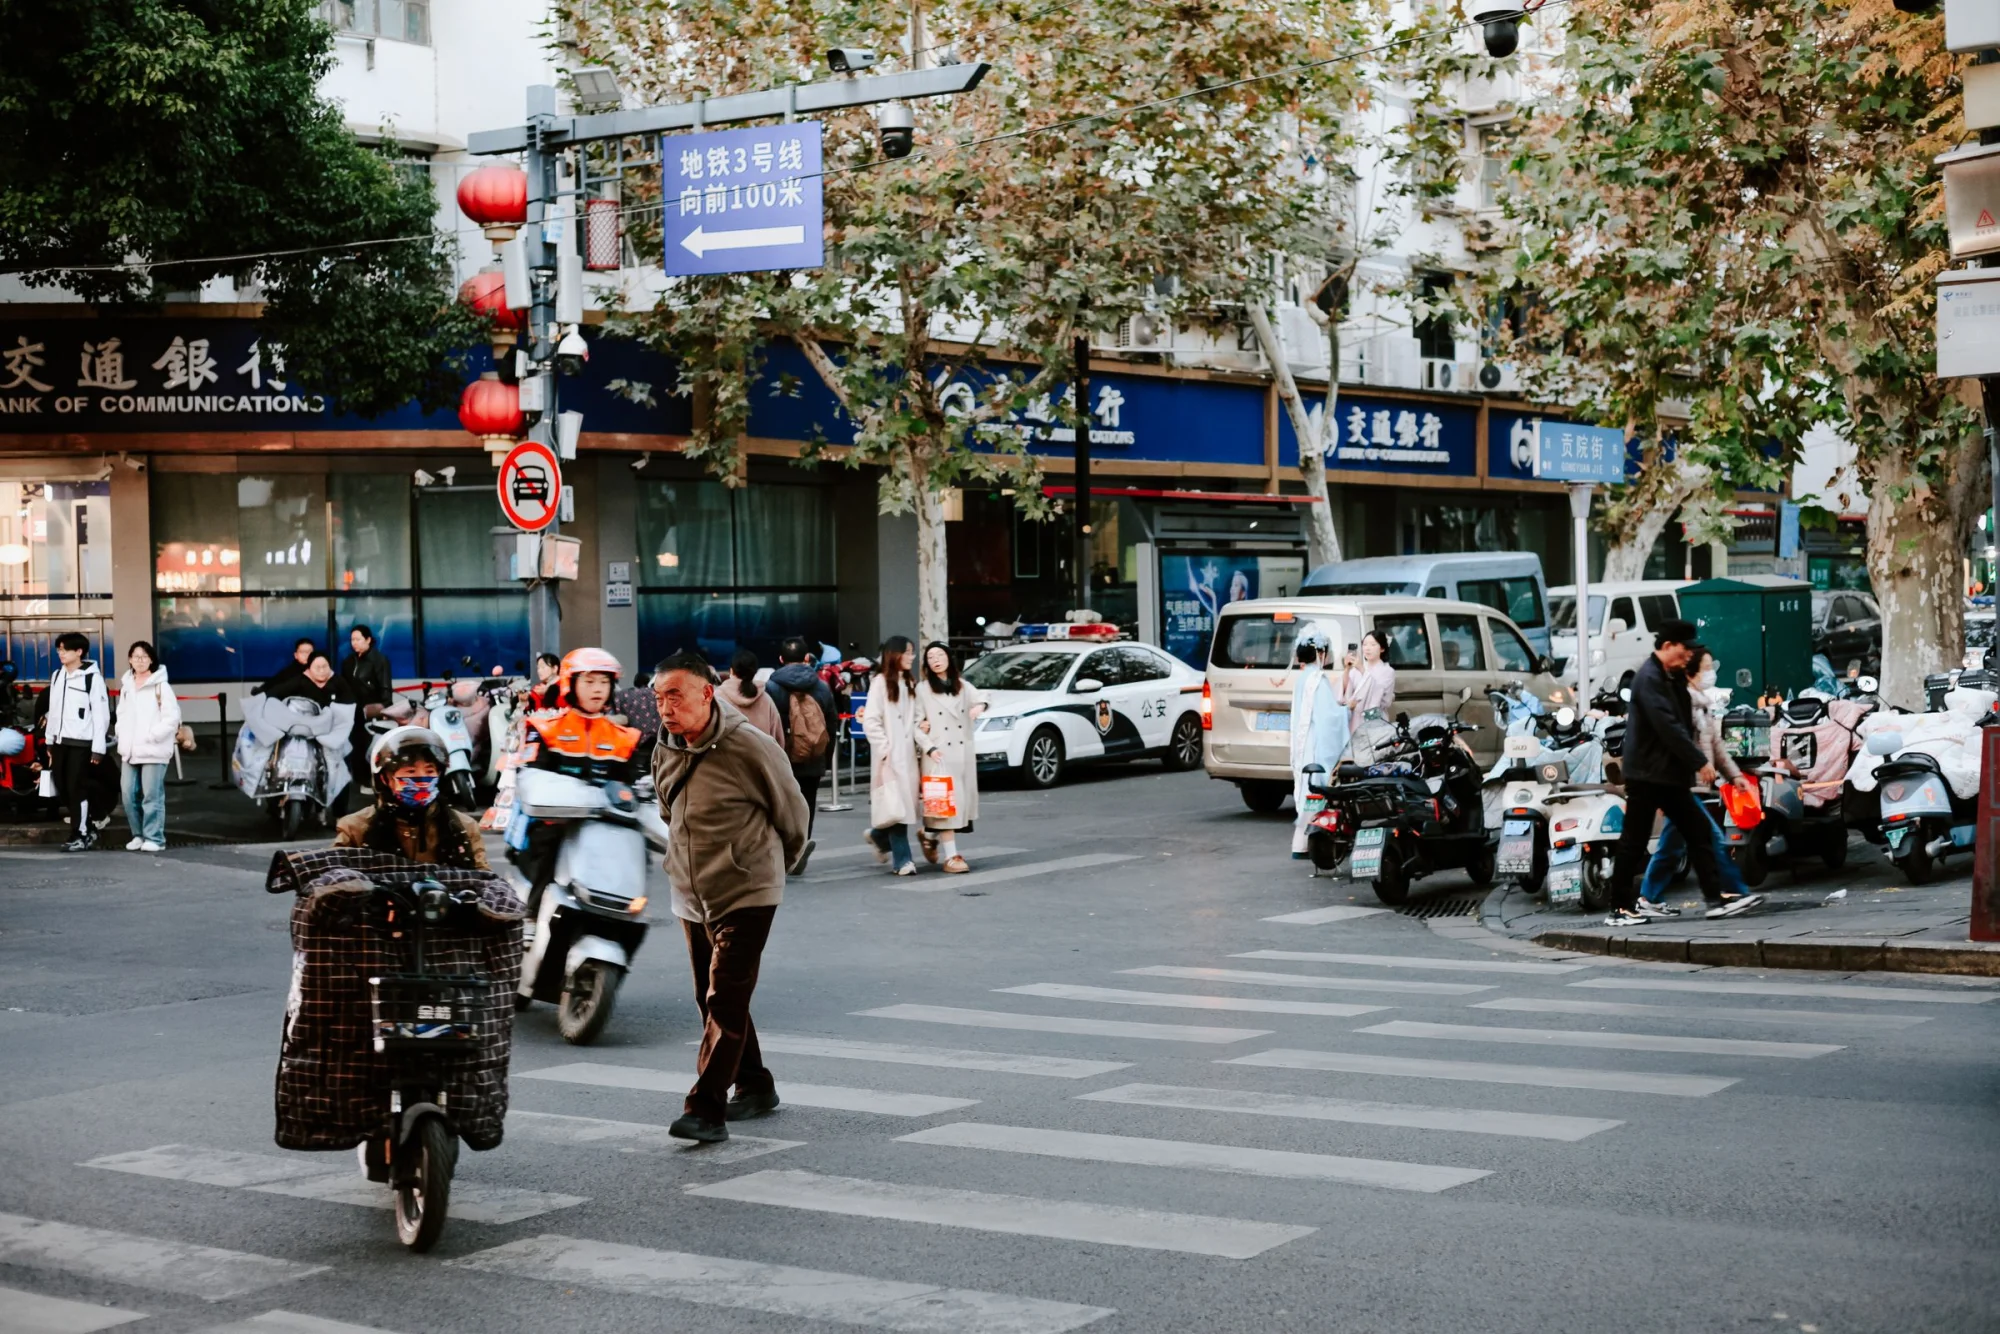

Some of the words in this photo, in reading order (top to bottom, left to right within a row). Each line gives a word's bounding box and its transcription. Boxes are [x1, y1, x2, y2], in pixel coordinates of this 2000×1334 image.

[680, 138, 804, 180] 地铁3号线
[679, 176, 804, 217] 向前100米
[54, 396, 89, 413] OF
[1561, 433, 1604, 461] 贡院街
[1141, 697, 1167, 719] 公安
